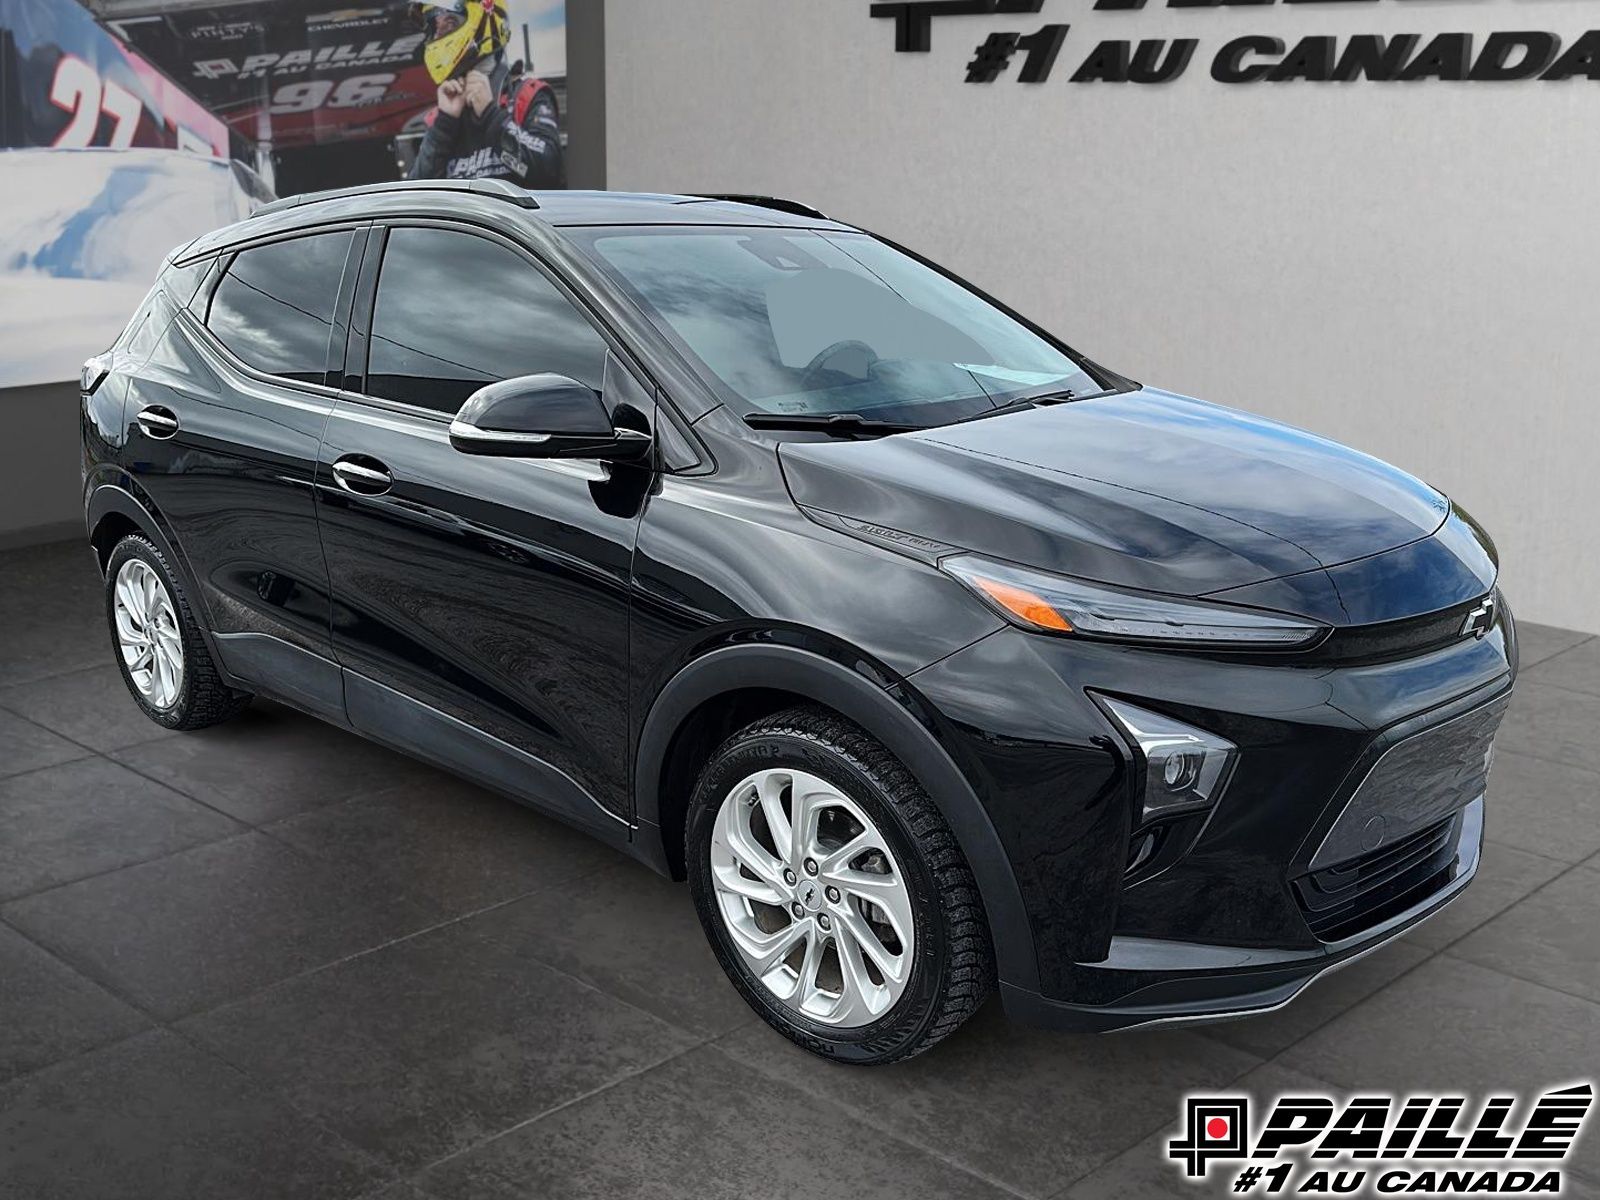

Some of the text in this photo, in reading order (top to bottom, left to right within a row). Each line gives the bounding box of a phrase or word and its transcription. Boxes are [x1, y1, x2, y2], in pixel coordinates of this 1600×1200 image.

[306, 17, 390, 32] CHEVROLET
[273, 64, 308, 76] AU
[314, 53, 414, 70] CANADA
[964, 24, 1600, 84] #1 AU CANADA
[269, 73, 396, 114] 96
